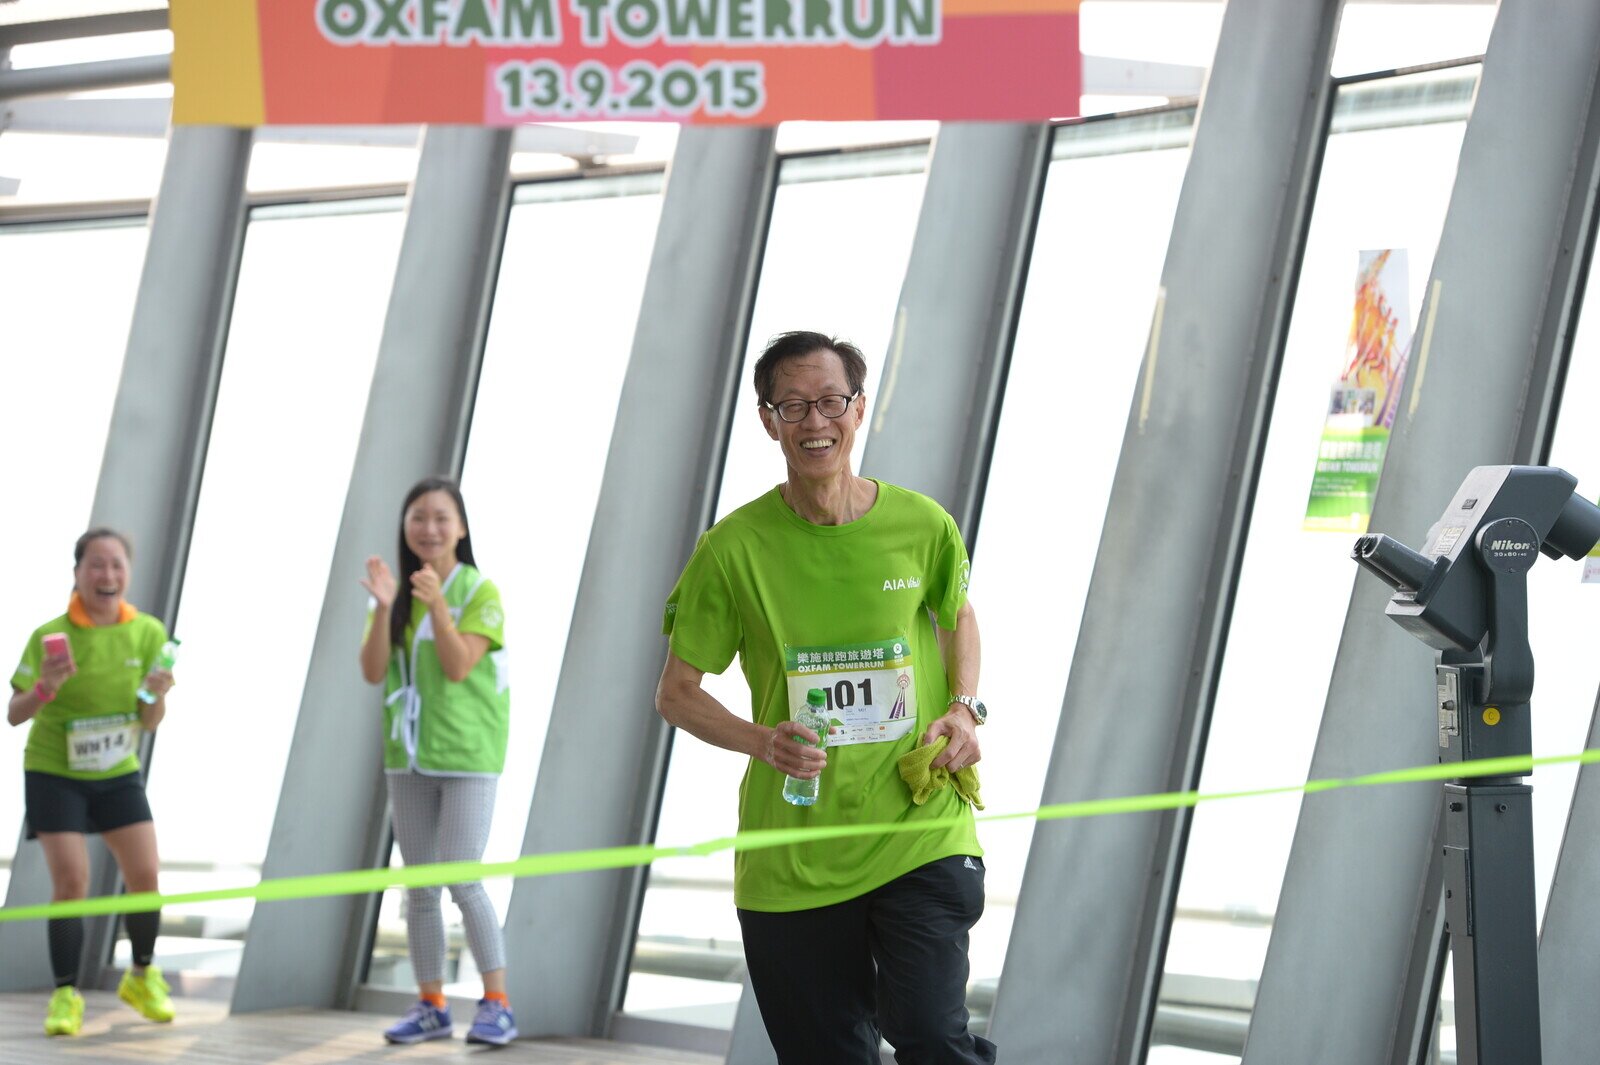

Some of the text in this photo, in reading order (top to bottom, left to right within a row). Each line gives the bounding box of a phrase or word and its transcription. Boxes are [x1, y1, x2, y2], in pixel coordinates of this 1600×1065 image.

[318, 0, 938, 43] OXFAM TOWERRUN
[499, 63, 763, 113] 13.9.2015
[1491, 540, 1530, 551] Nikon
[883, 579, 905, 591] AIA
[797, 647, 885, 664] 樂施競跑旅遊塔
[797, 660, 885, 673] OXFAM TOWERRUN
